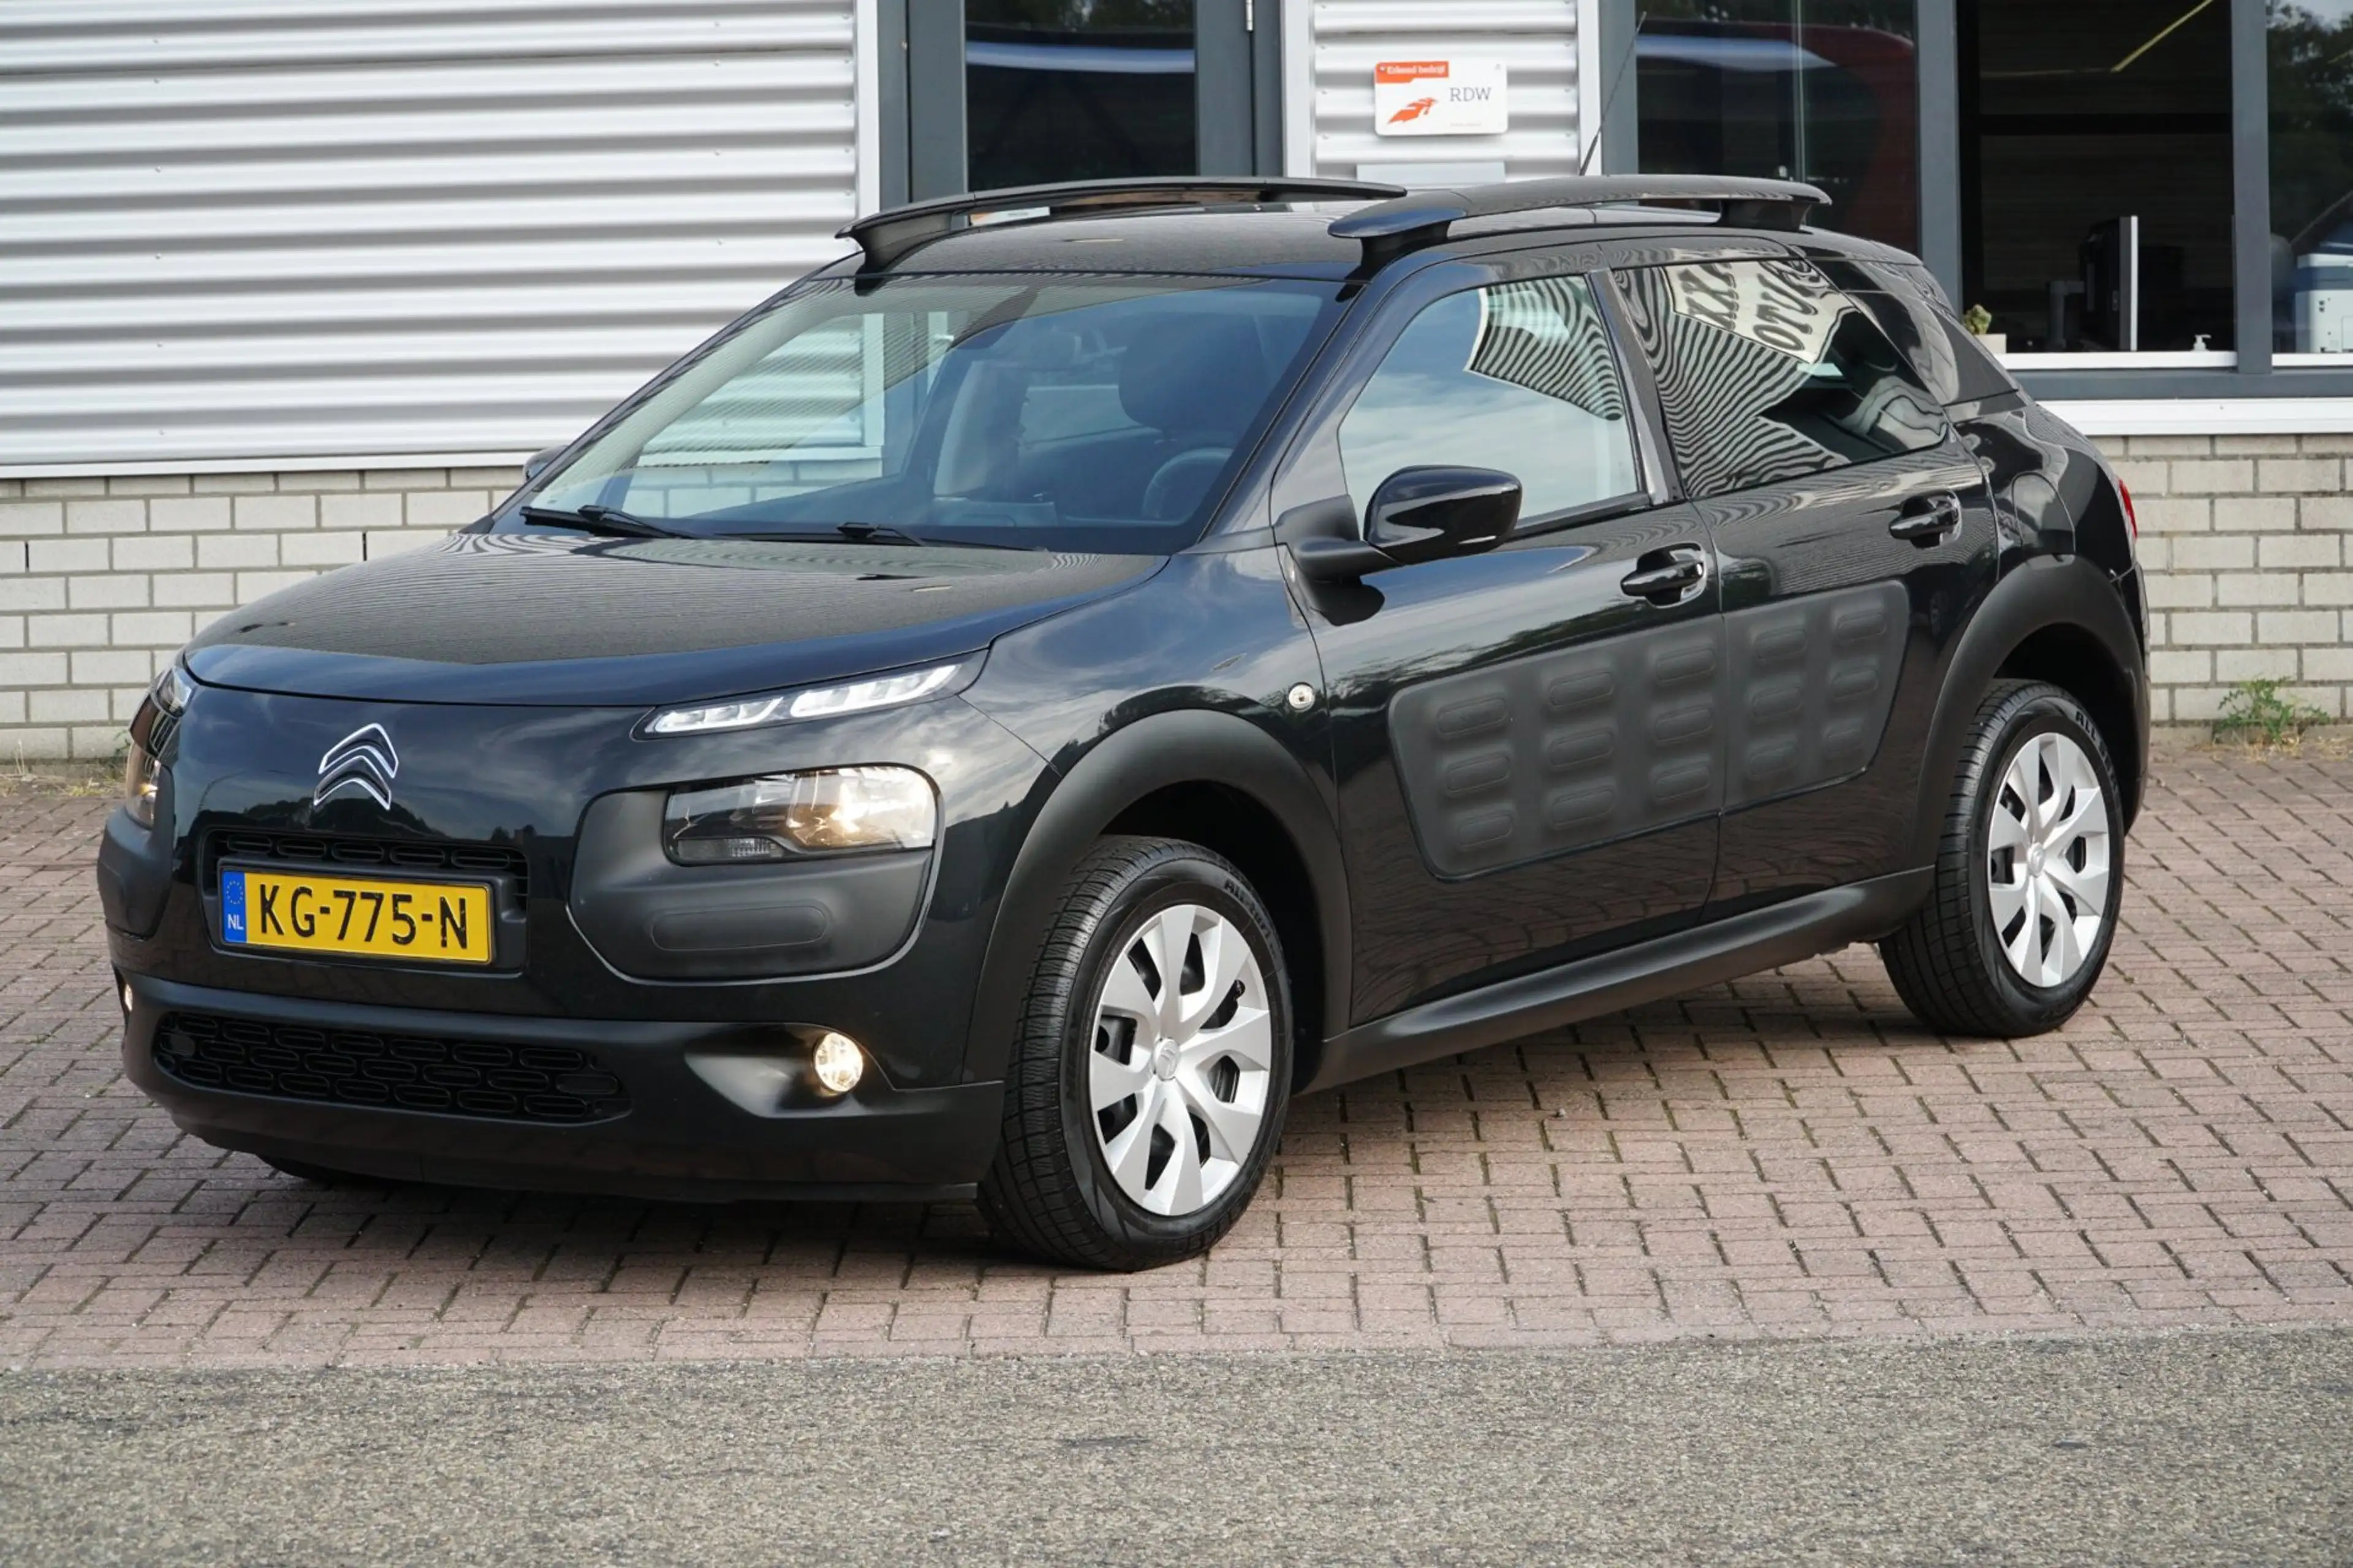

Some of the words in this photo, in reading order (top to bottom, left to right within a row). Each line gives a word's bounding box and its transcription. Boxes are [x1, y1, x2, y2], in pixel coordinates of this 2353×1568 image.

[1450, 87, 1491, 102] RDW
[227, 914, 244, 931] NL
[259, 884, 468, 949] KG-775-N
